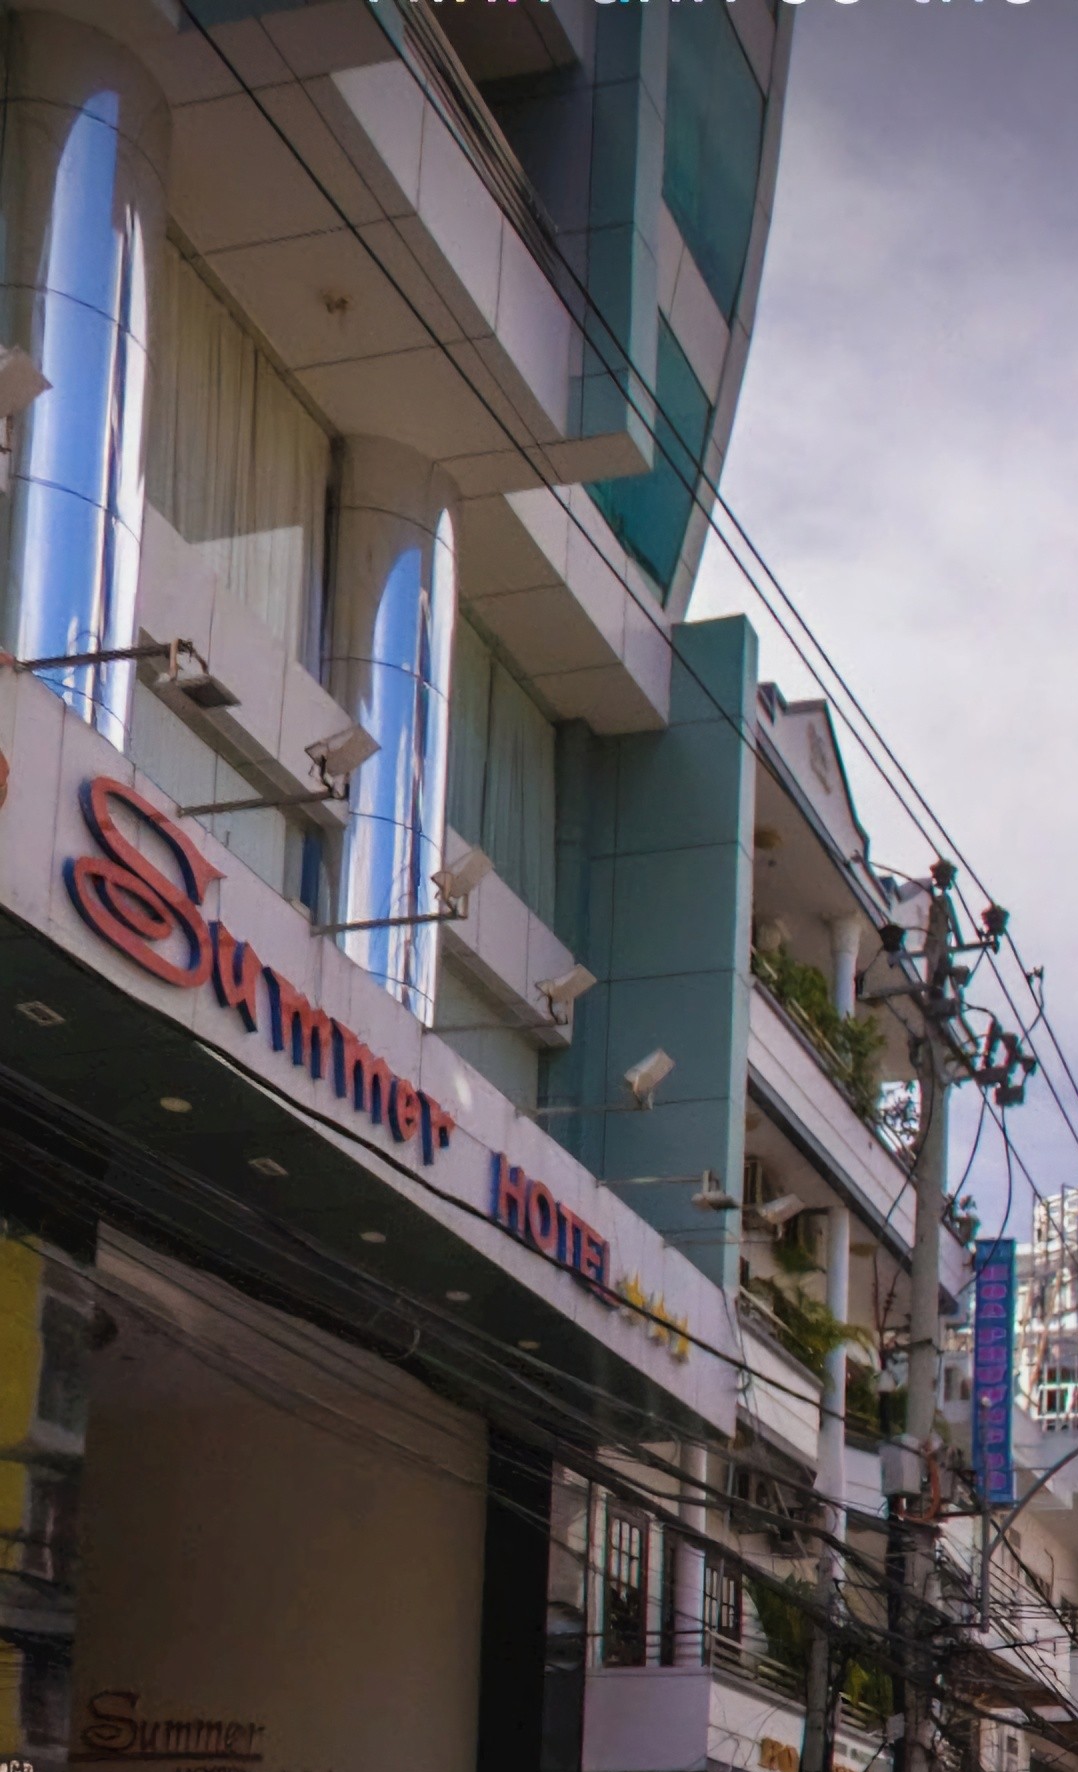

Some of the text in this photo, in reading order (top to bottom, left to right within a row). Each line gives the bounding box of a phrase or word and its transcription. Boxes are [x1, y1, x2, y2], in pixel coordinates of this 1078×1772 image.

[62, 776, 622, 1312] Summer HOTEL
[78, 1690, 265, 1752] Summer
